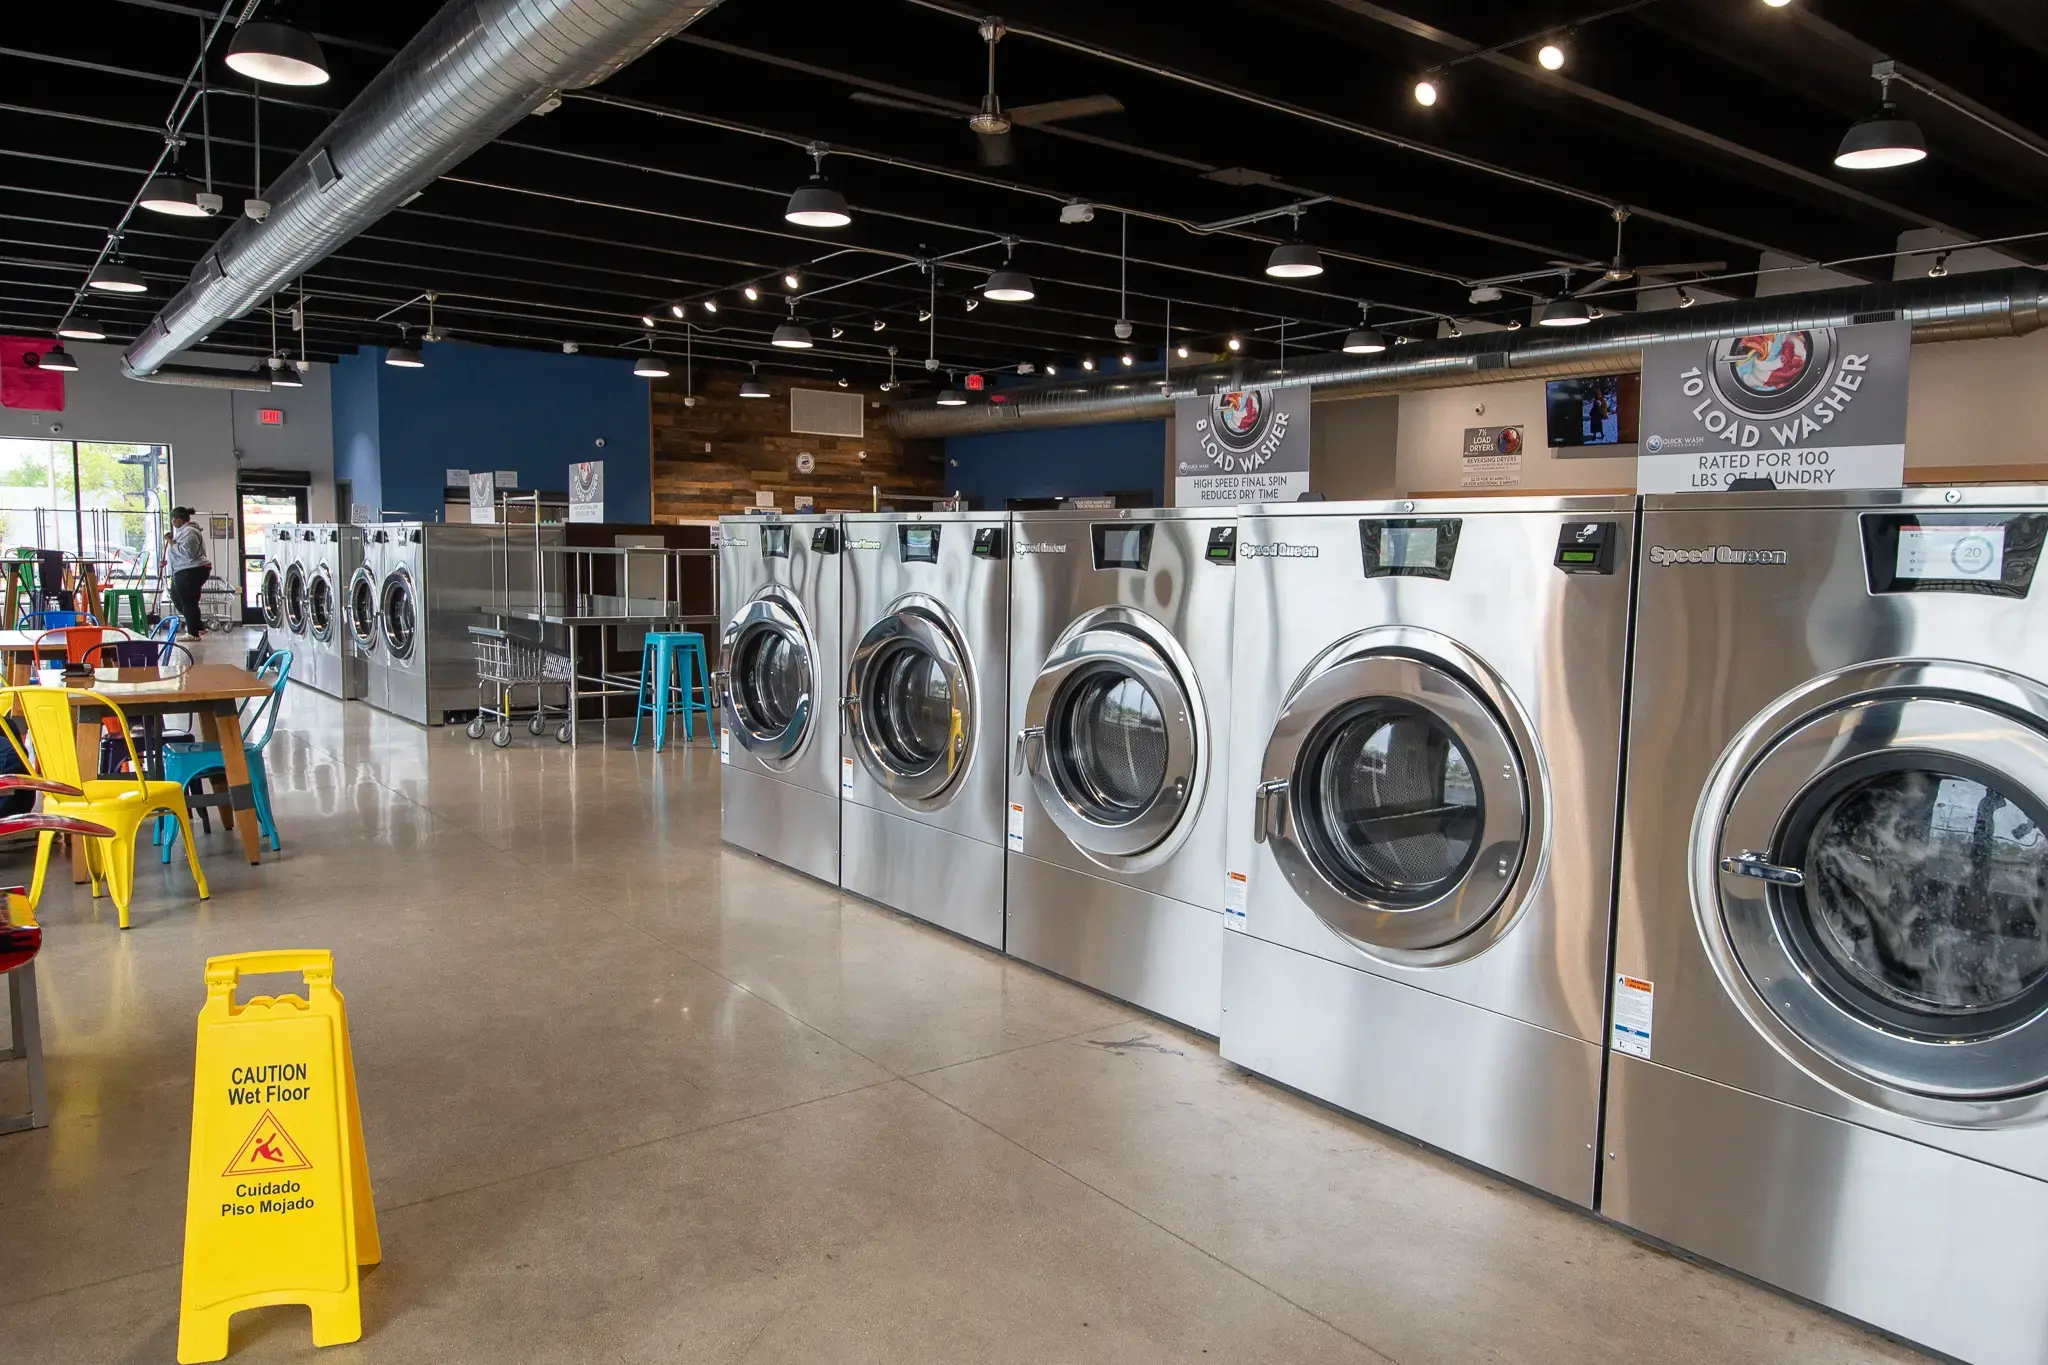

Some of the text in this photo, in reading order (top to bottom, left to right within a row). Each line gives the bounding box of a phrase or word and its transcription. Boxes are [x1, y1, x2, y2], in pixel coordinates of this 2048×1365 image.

[1680, 353, 1869, 448] 10 LOAD WASHER
[262, 410, 280, 423] EXIT
[1196, 412, 1290, 473] 8 LOAD WASHER
[1470, 444, 1494, 452] DRYERS
[1663, 436, 1704, 445] QUICK WASH
[1699, 451, 1829, 469] RATED FOR 100
[1194, 476, 1287, 488] HIGH SPEED FINAL SPIN
[1692, 473, 1717, 487] LBS
[1201, 489, 1278, 500] REDUCES DRY TIME
[1240, 543, 1318, 558] Speed Queen
[1649, 545, 1788, 566] Speed Queen
[1964, 548, 1982, 558] 20
[232, 1063, 307, 1085] CAUTION
[228, 1085, 310, 1105] Wet Floor
[236, 1180, 300, 1197] Cuidado
[221, 1197, 314, 1216] Piso Mojado
